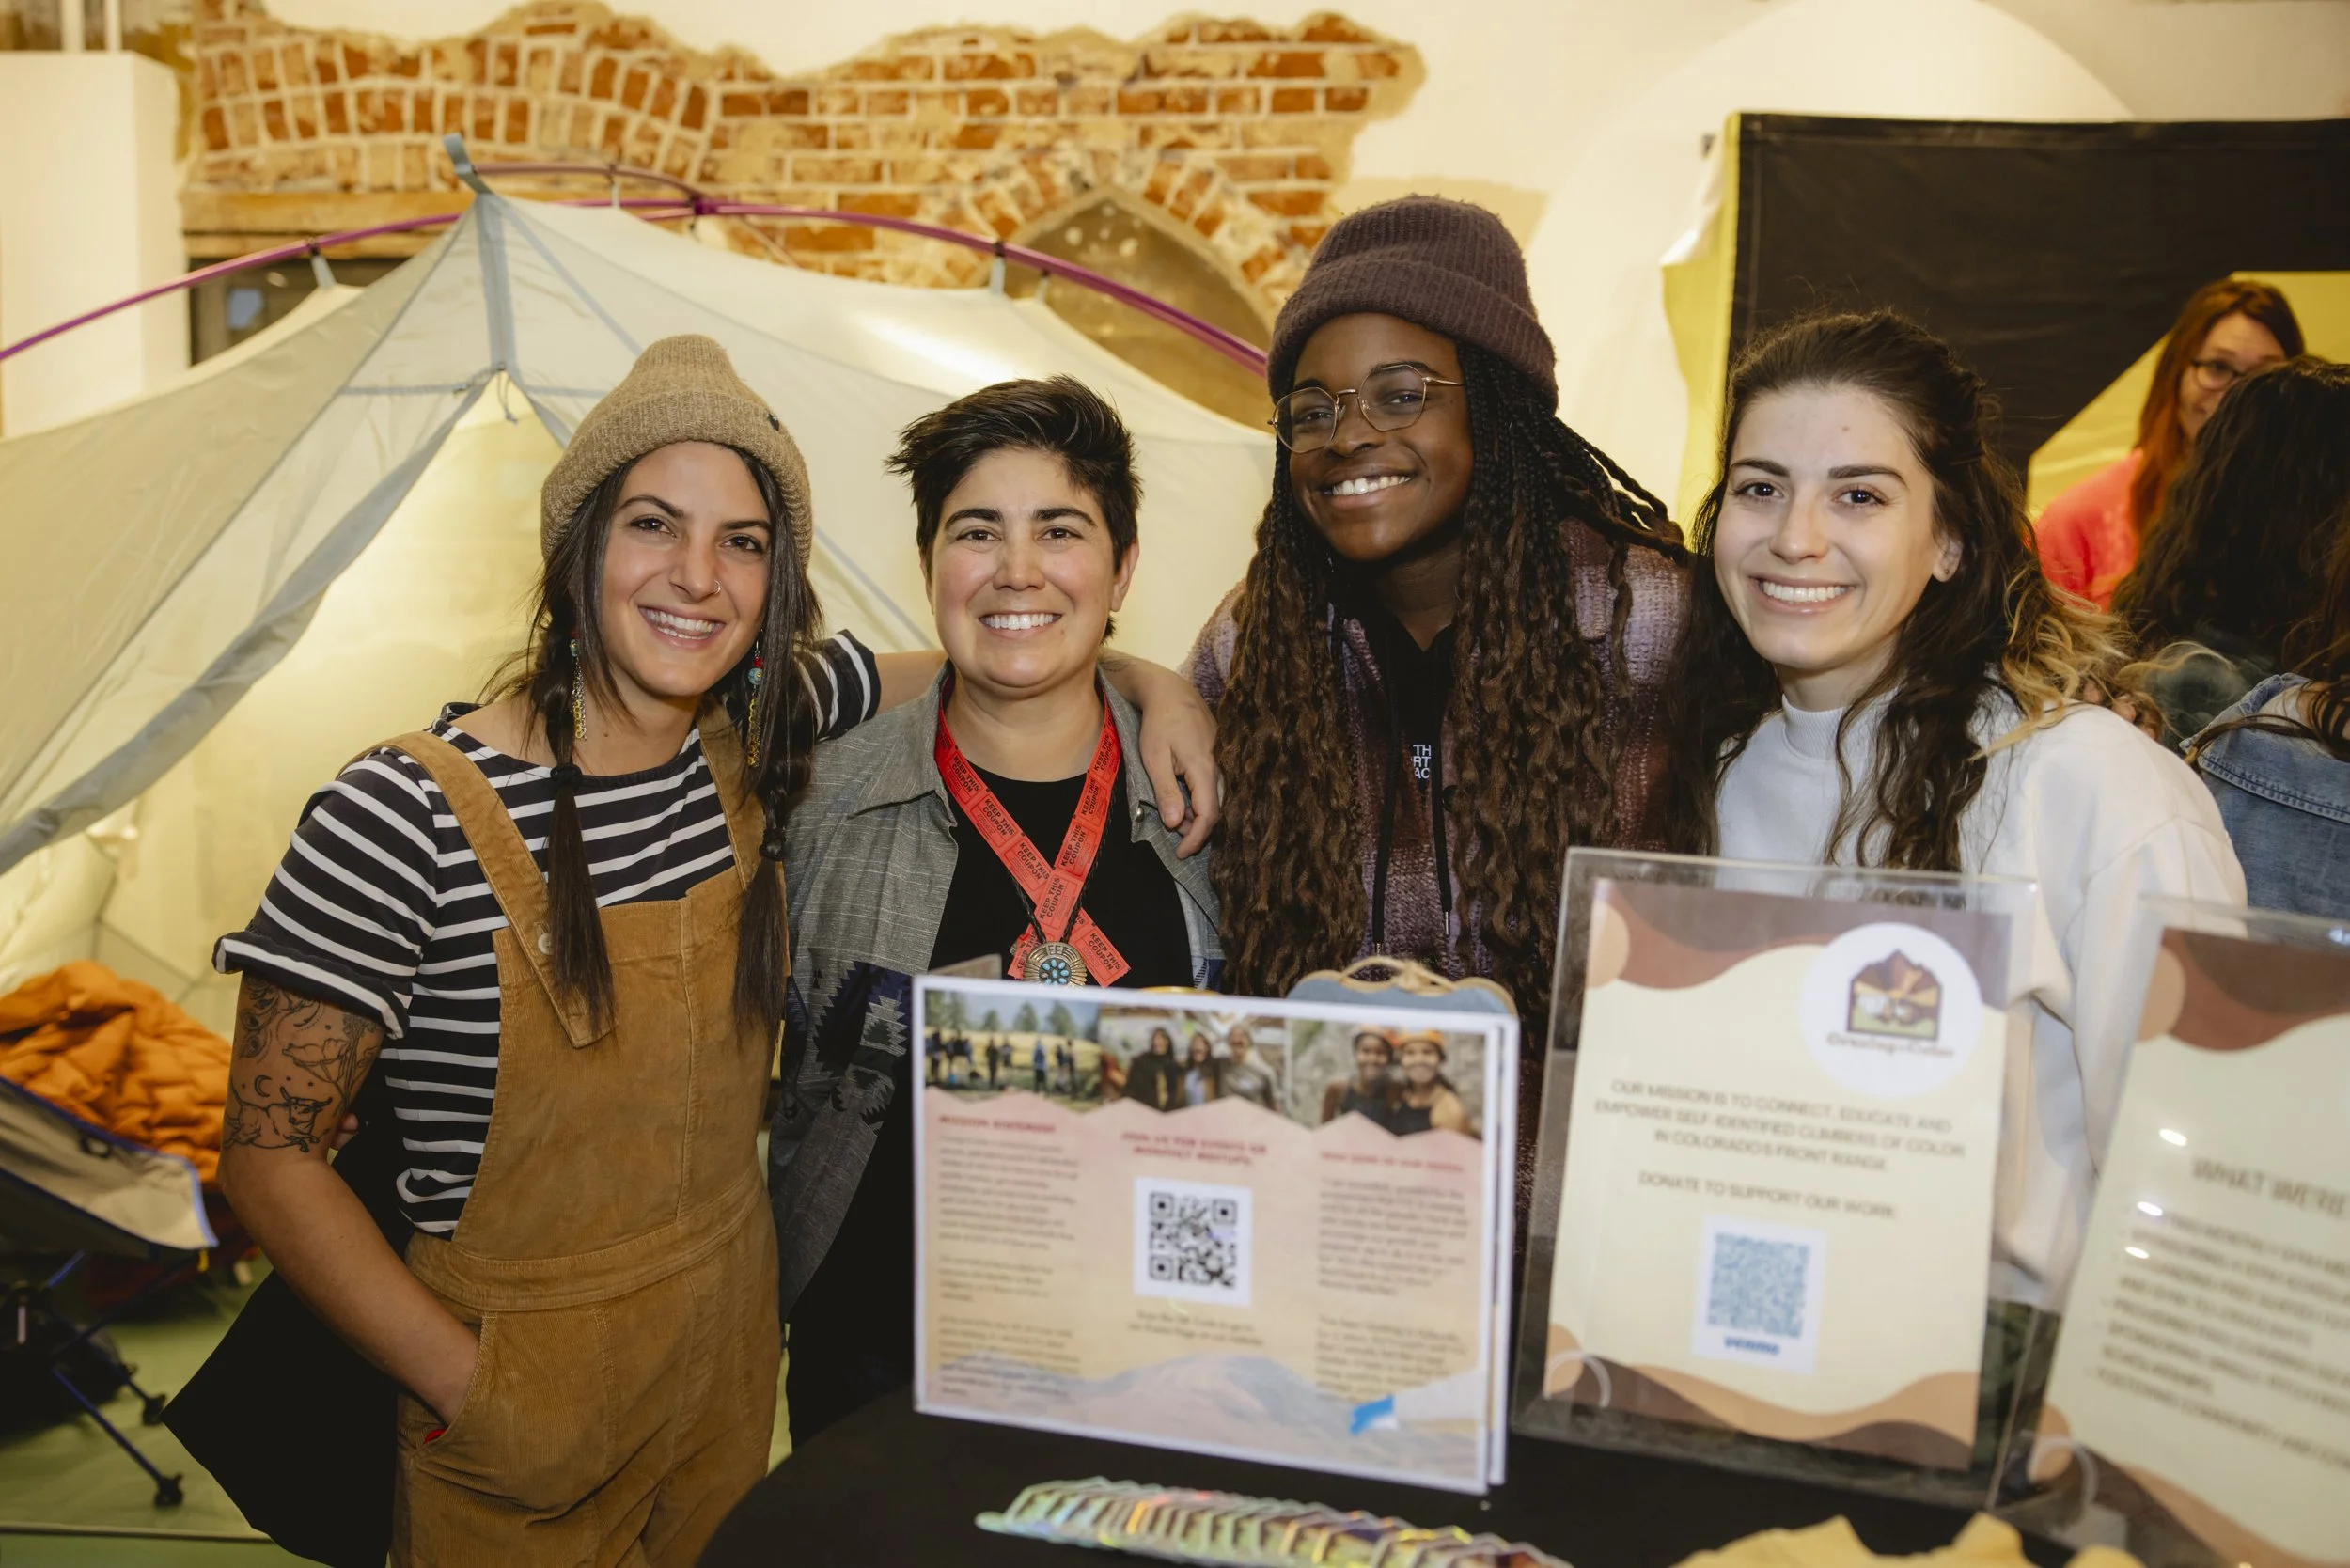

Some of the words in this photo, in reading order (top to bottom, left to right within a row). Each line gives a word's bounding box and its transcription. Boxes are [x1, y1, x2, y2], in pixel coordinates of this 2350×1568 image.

[1411, 756, 1431, 767] RT
[1413, 744, 1432, 756] TH
[952, 763, 974, 792] COUPON
[953, 756, 967, 774] KEEP
[966, 774, 980, 792] THIS
[1415, 767, 1430, 779] AC
[1081, 795, 1091, 816] KEEP
[1088, 779, 1096, 794] THIS
[1088, 786, 1100, 814] COUPON
[982, 806, 1007, 836] COUPON
[985, 798, 1001, 817] KEEP
[1000, 818, 1015, 836] THIS
[1019, 842, 1037, 861] KEEP
[1036, 862, 1050, 880] THIS
[1060, 844, 1073, 867] KEEP
[1071, 824, 1082, 841] THIS
[1069, 831, 1086, 865] COUPON
[1017, 850, 1042, 880] COUPON
[1039, 898, 1051, 919] KEEP
[1049, 878, 1060, 895] THIS
[1046, 884, 1065, 917] COUPON
[1089, 941, 1113, 970] COUPON
[1090, 933, 1107, 952] KEEP
[1106, 952, 1121, 970] THIS
[1594, 1098, 1670, 1121] EMPOWER
[1611, 1078, 1643, 1095] OUR
[1647, 1083, 1710, 1104] MISSION
[1715, 1091, 1728, 1106] IS
[1731, 1093, 1752, 1109] TO
[1839, 1106, 1910, 1128] EDUCATE
[1916, 1117, 1953, 1134] AND
[1776, 1144, 1826, 1163] FRONT
[1637, 1171, 1699, 1193] DONATE
[1704, 1179, 1725, 1196] TO
[1729, 1183, 1800, 1205] SUPPORT
[1804, 1193, 1841, 1211] OUR
[2193, 1158, 2265, 1195] WHAT
